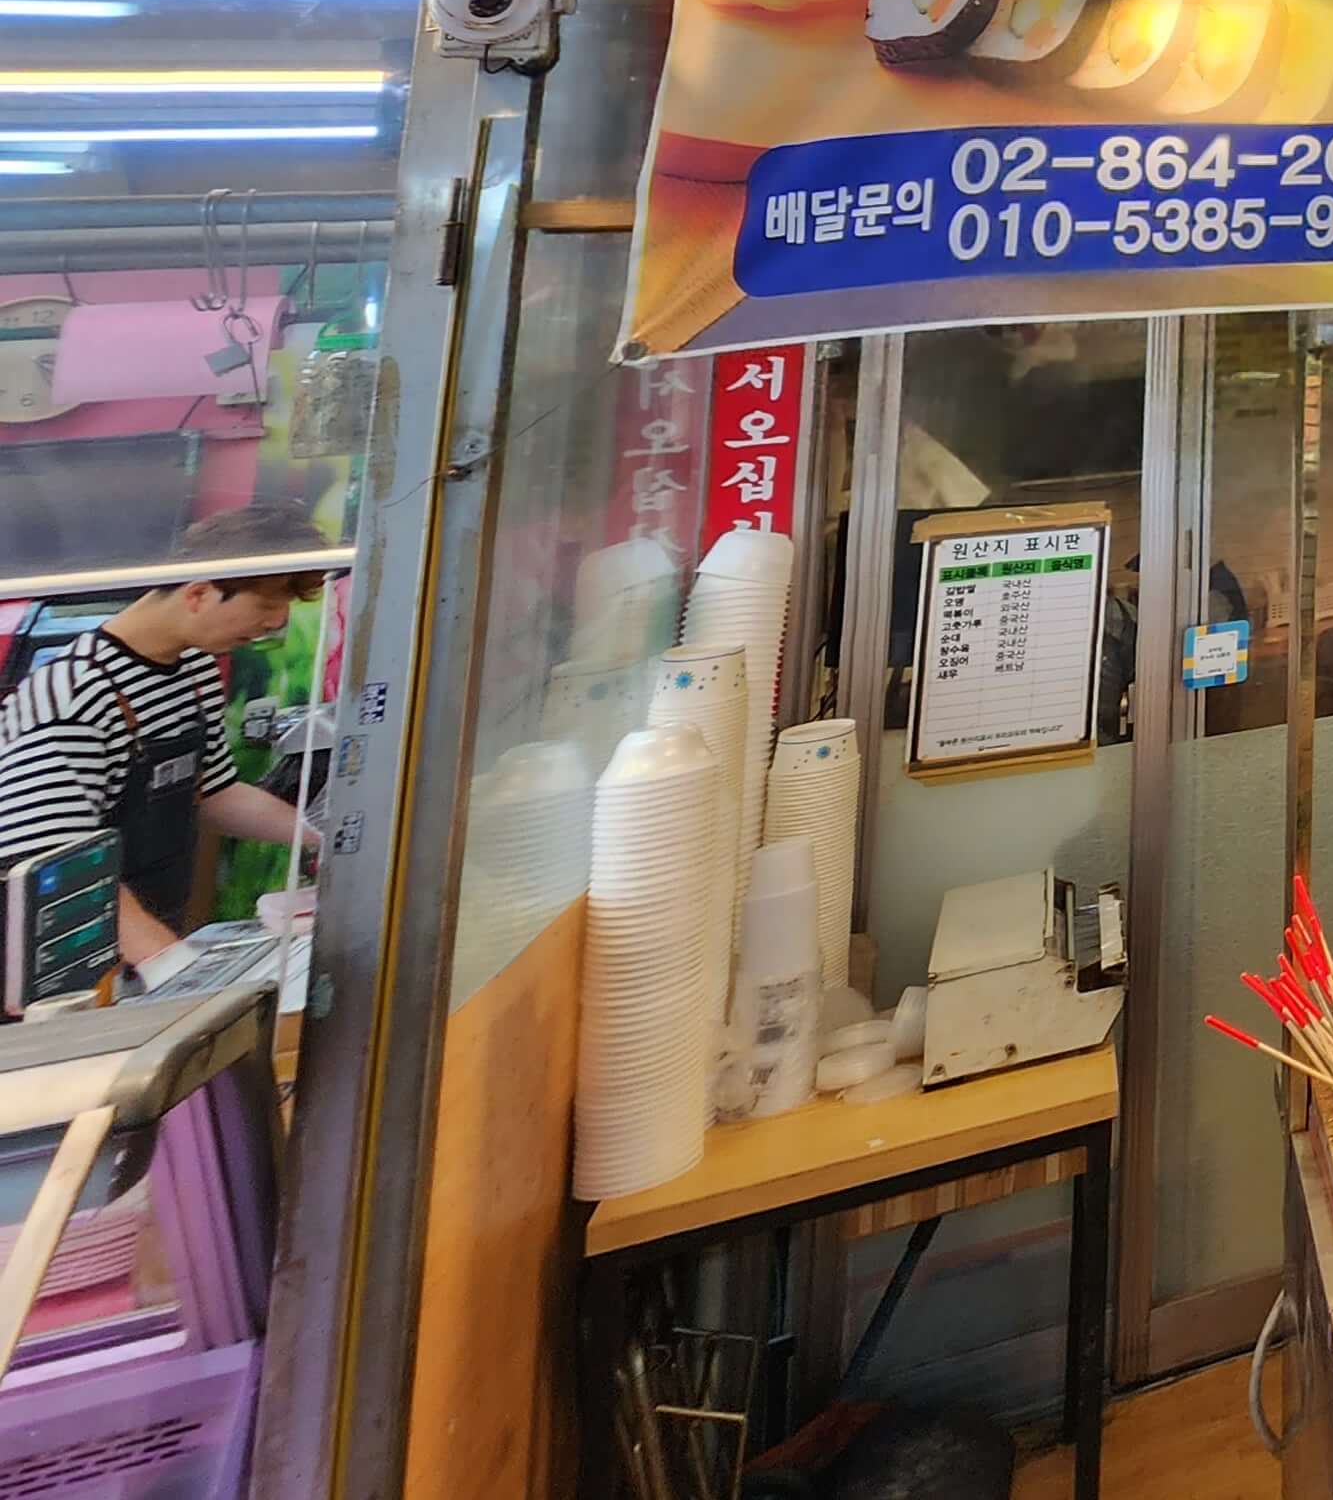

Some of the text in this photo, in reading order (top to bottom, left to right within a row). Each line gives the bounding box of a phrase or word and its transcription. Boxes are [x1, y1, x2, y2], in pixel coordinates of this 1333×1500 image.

[763, 175, 934, 246] 배달문의
[951, 533, 1082, 561] 원산지 표시판
